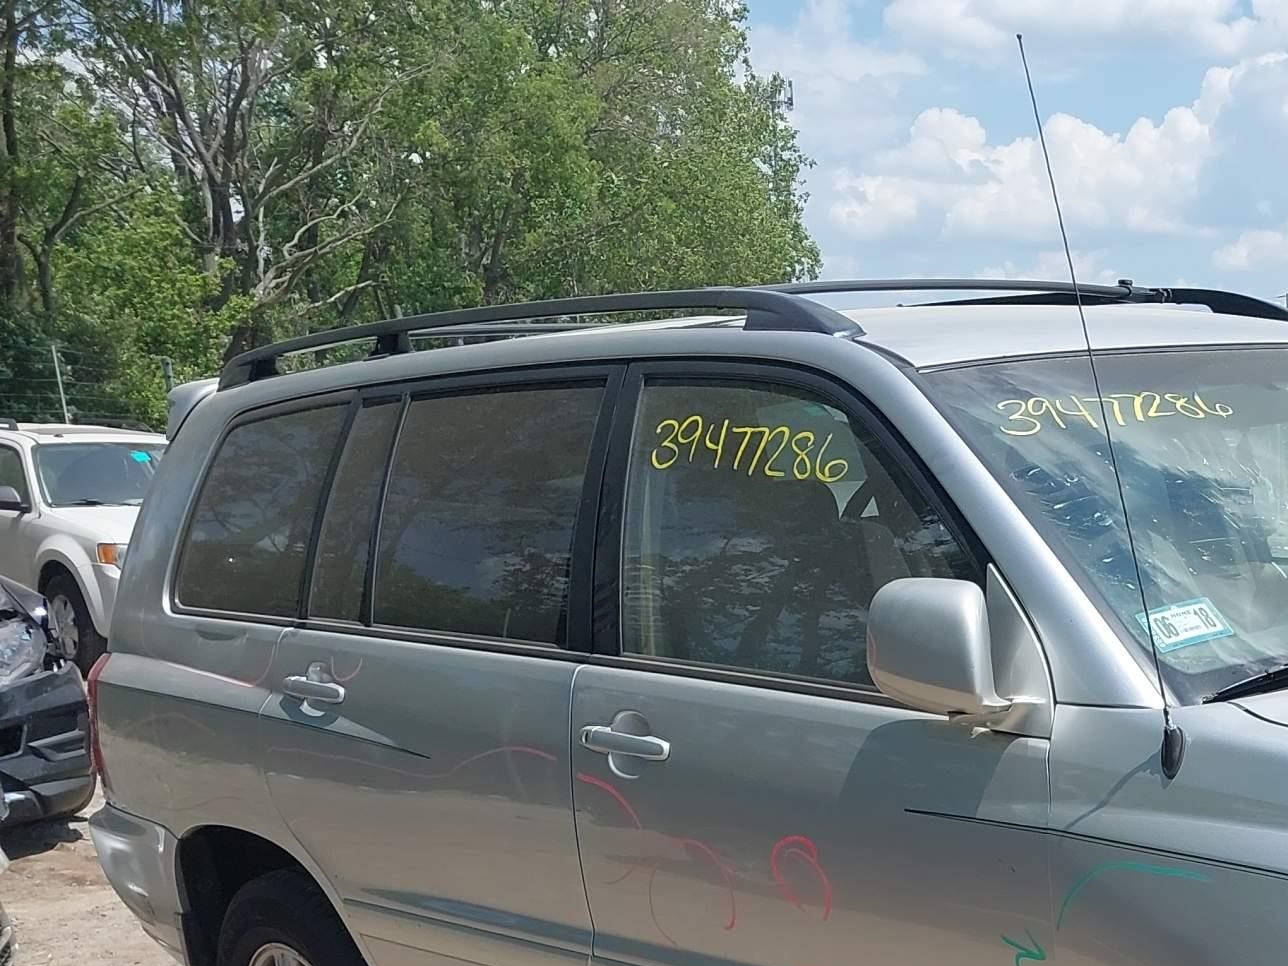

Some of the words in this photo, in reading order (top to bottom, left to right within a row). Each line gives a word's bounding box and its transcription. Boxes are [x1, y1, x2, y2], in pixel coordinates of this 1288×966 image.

[997, 392, 1233, 436] 39477286
[651, 415, 849, 483] 39477286
[1153, 615, 1180, 639] 06
[1193, 607, 1217, 630] 18
